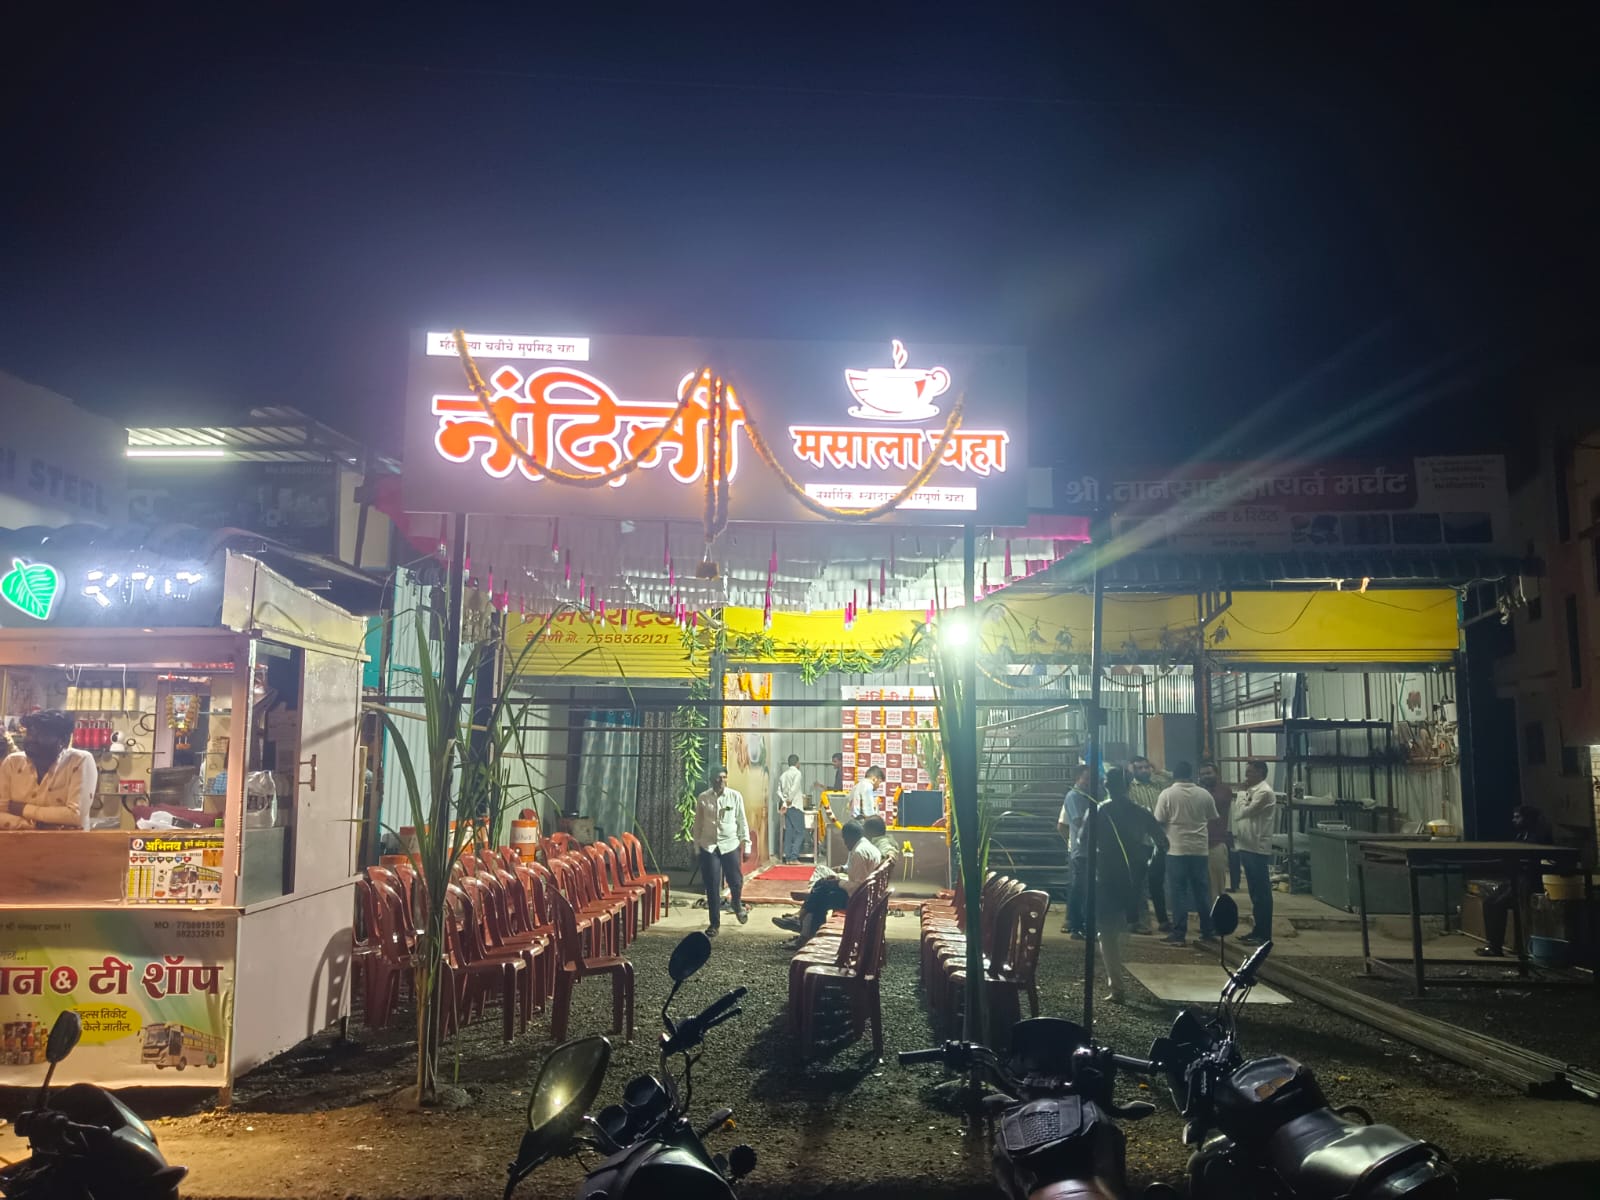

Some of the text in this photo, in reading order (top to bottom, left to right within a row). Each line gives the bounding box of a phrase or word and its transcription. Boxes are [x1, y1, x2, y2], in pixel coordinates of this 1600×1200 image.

[433, 367, 745, 486] नंदिनी
[790, 427, 1009, 475] मसाला चहा
[28, 457, 109, 515] STEEL
[145, 839, 182, 851] अभिनव
[0, 966, 48, 996] ान
[89, 956, 133, 996] टी
[141, 955, 224, 999] शॉप
[83, 1020, 101, 1032] केले
